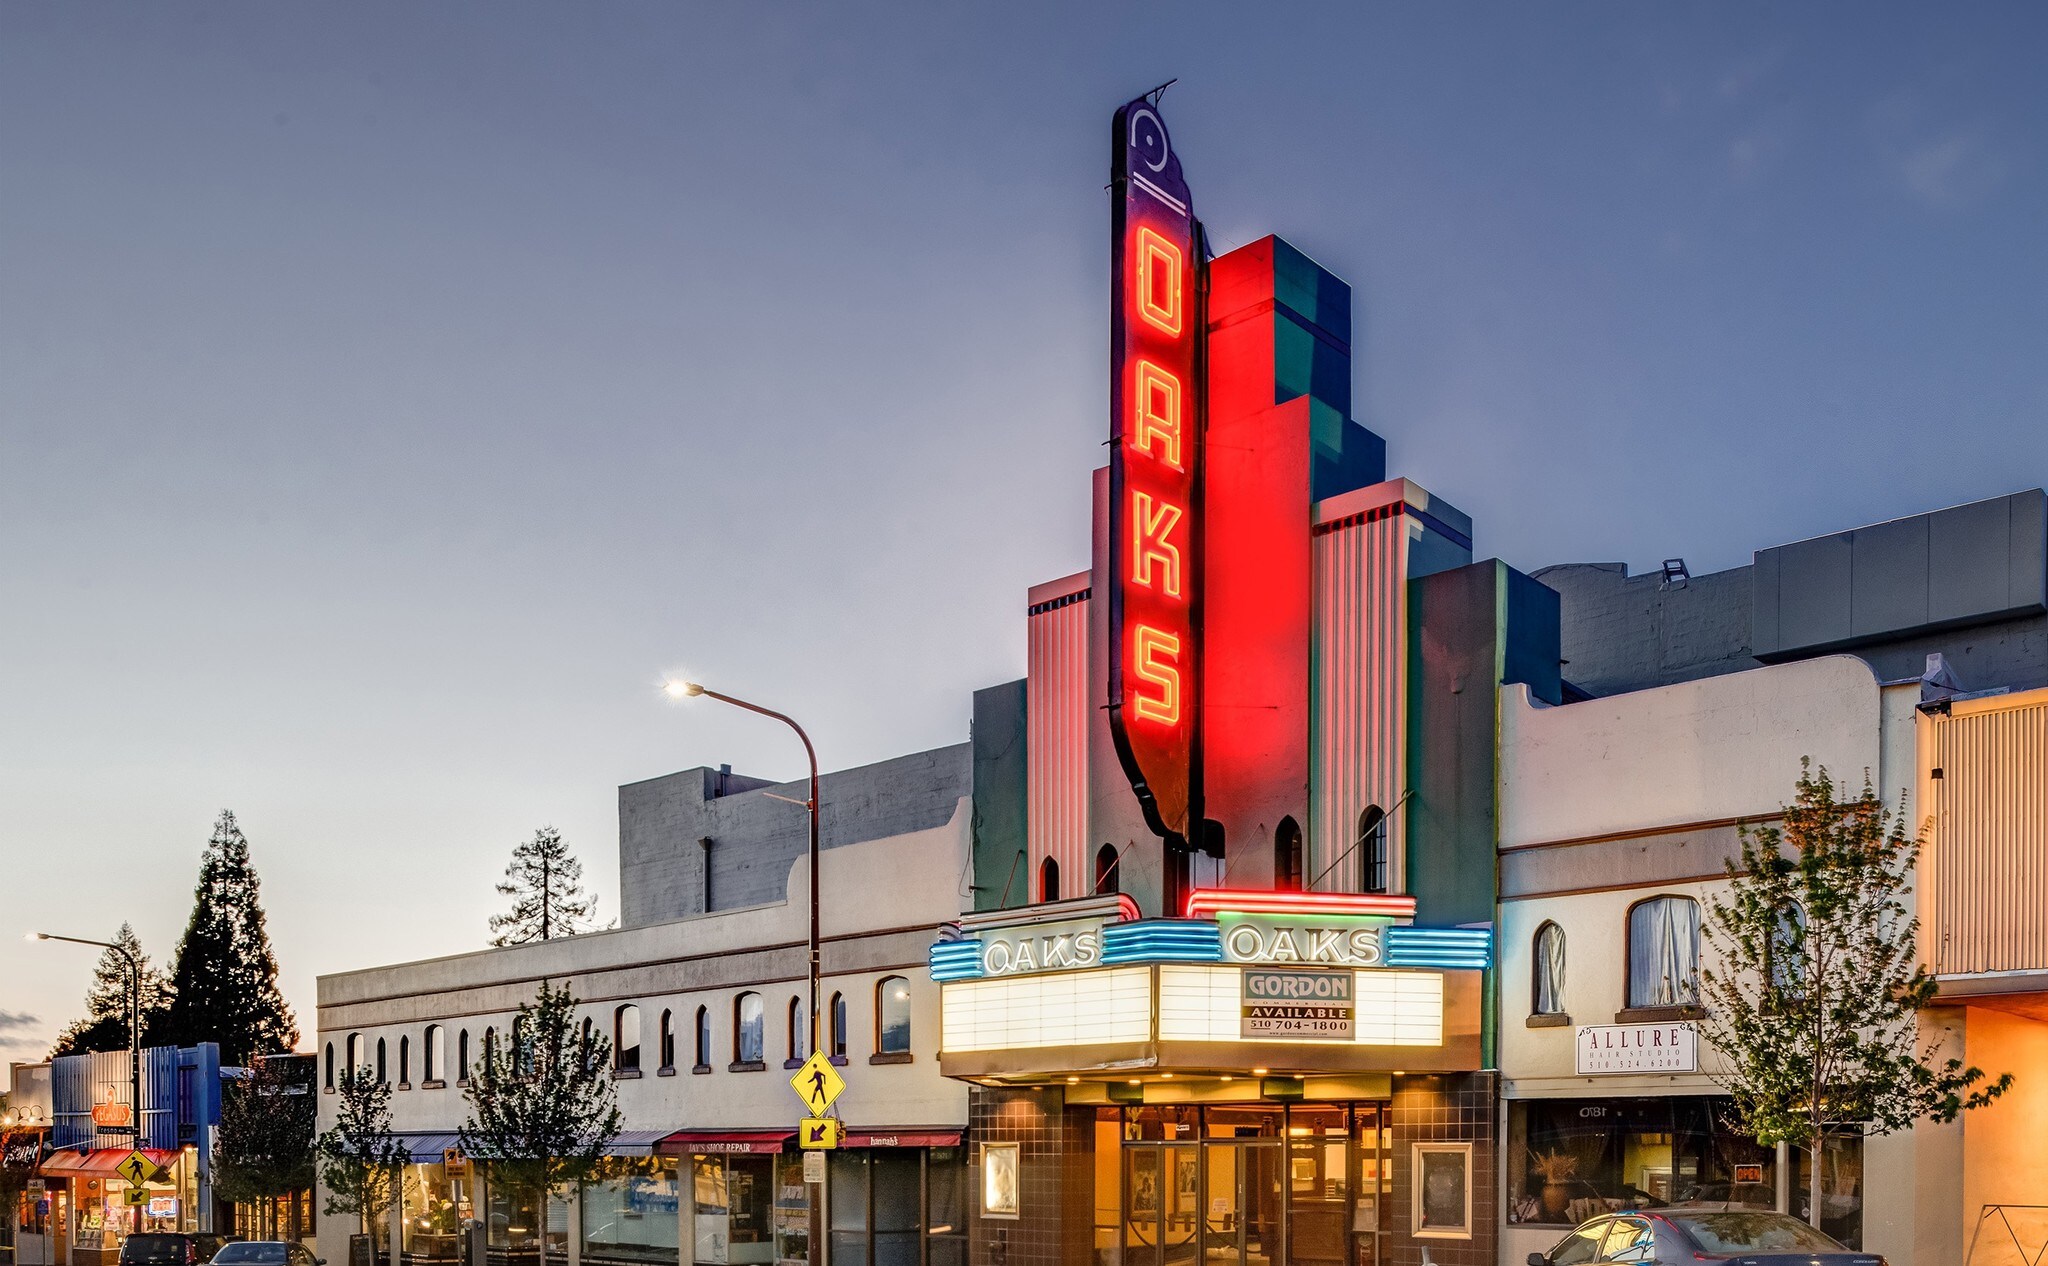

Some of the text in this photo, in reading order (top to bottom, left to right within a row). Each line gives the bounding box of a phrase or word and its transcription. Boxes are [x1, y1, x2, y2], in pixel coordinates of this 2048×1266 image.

[1131, 225, 1184, 725] OAKS
[1227, 924, 1382, 964] OAKS
[984, 928, 1100, 974] OAKS
[1249, 975, 1348, 998] GORDON
[1251, 1007, 1347, 1019] AVAILABLE
[1250, 1020, 1348, 1031] 510 704-1800
[1590, 1028, 1680, 1049] ALLURE
[1589, 1049, 1680, 1059] HAIR STUDIO
[1589, 1058, 1680, 1069] 510.524.6200
[870, 1136, 898, 1146] hannah's
[689, 1143, 751, 1152] JAY'S SHOE REPAIR
[1737, 1168, 1760, 1181] OPEN
